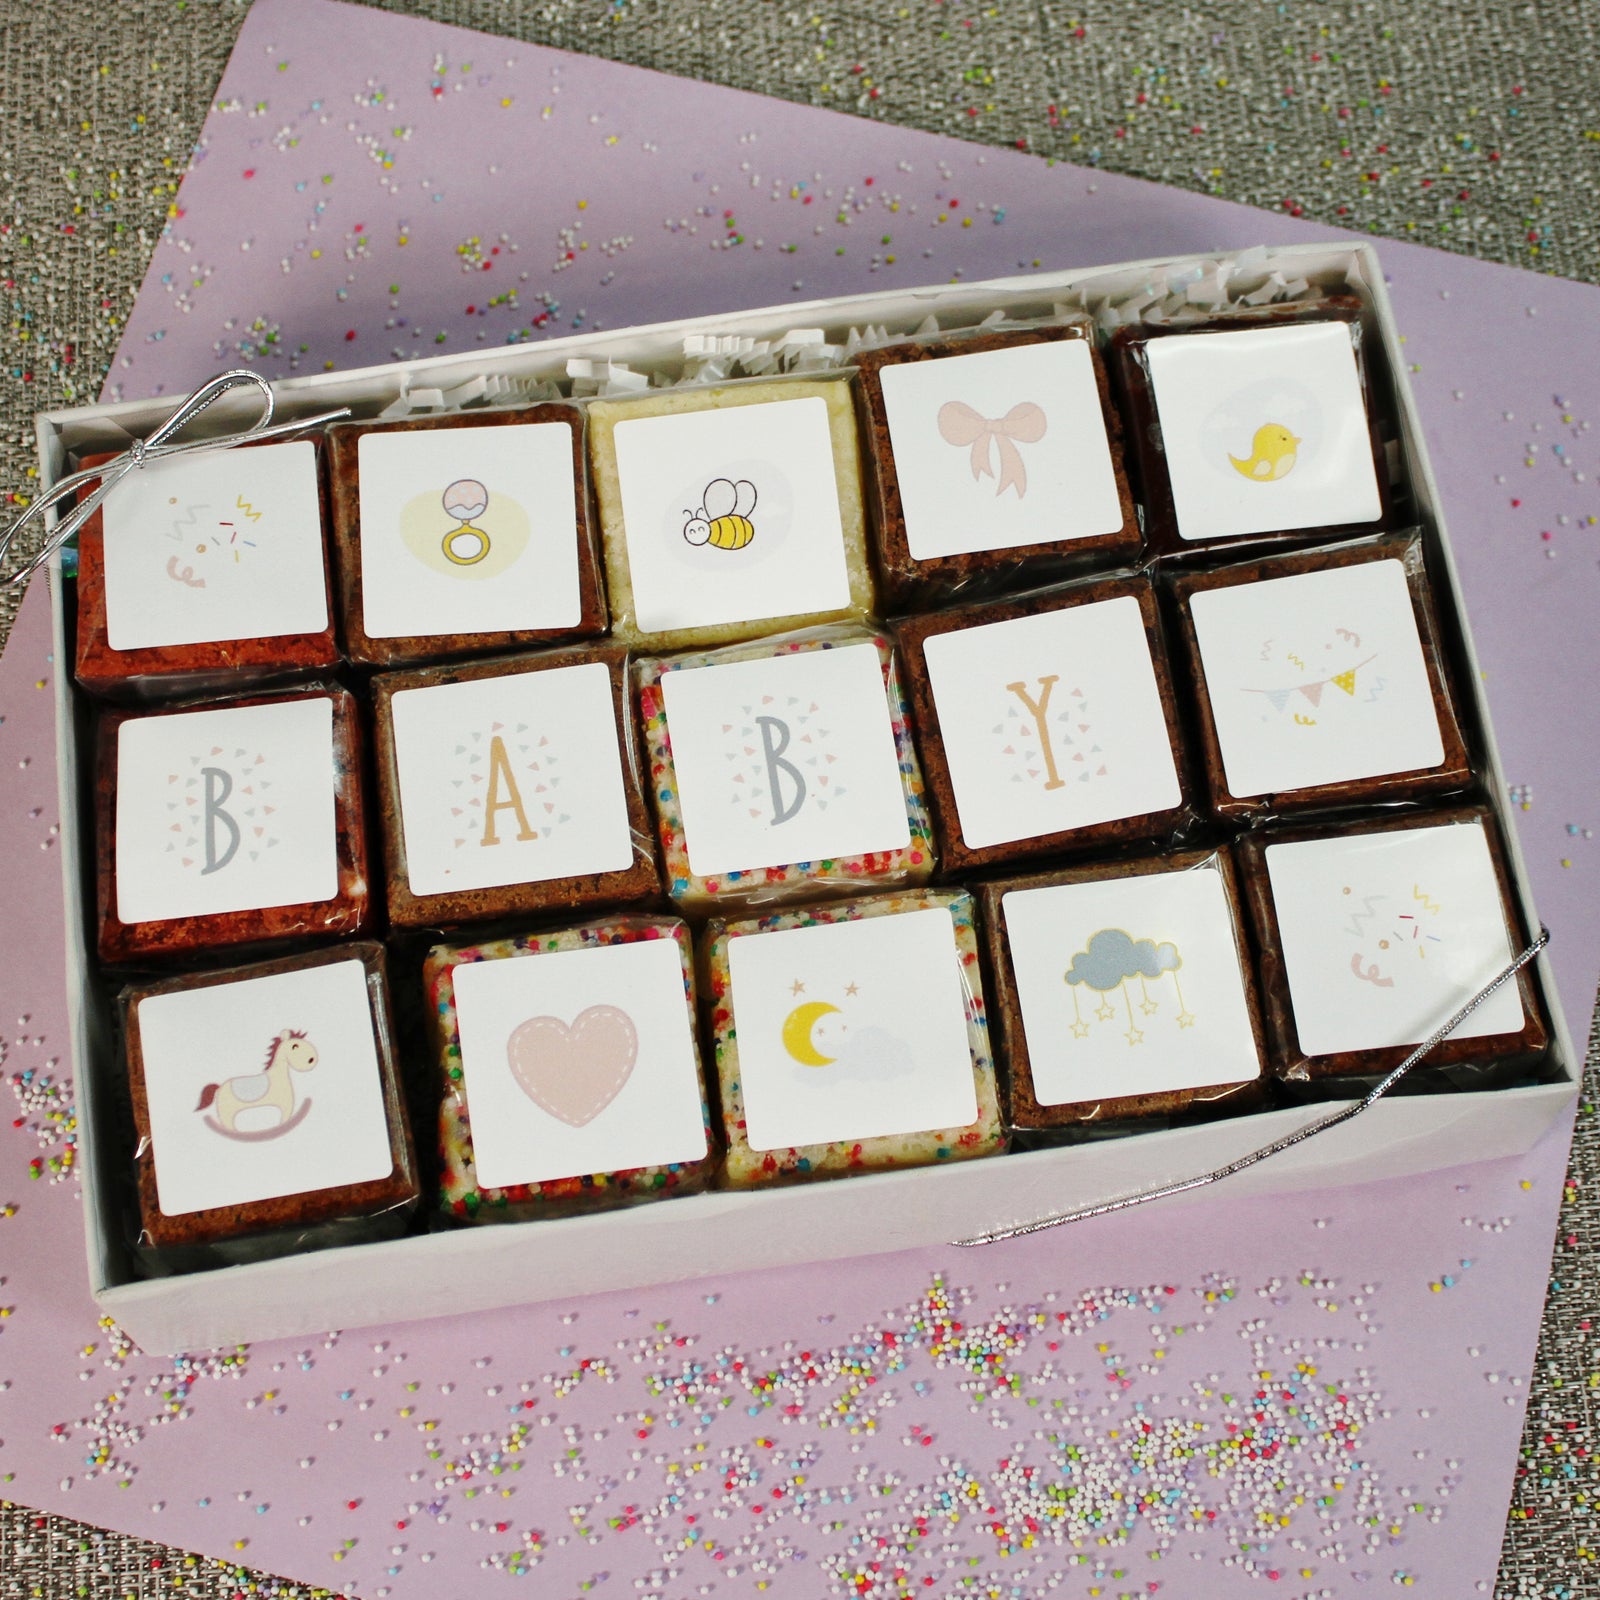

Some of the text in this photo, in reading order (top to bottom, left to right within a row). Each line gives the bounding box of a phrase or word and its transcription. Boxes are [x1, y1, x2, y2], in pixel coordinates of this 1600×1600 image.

[200, 674, 1065, 876] B A B Y
